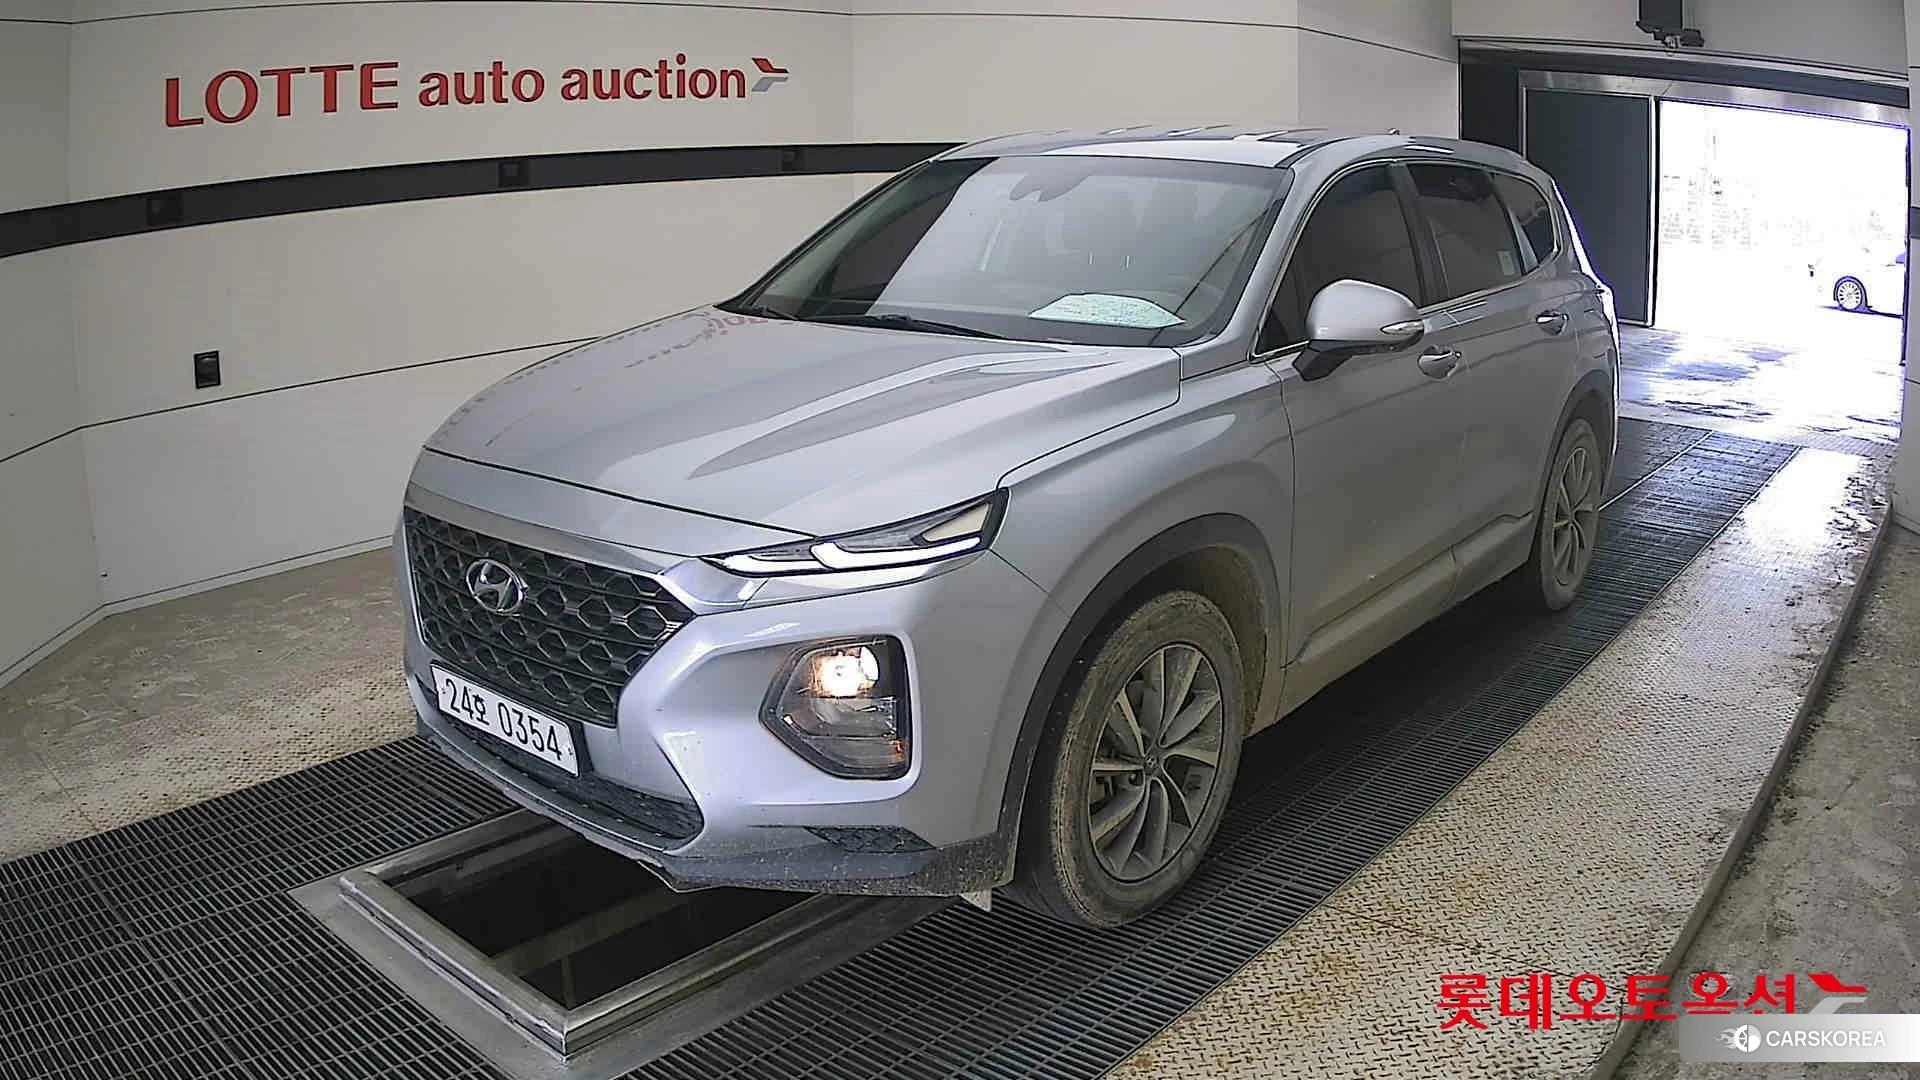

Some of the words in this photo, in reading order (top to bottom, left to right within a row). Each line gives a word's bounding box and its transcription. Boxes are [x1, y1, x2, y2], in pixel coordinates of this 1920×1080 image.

[164, 61, 399, 128] LOTTE
[417, 60, 546, 108] auto
[560, 52, 747, 101] auction
[445, 678, 490, 726] 24호
[498, 702, 563, 762] 0354
